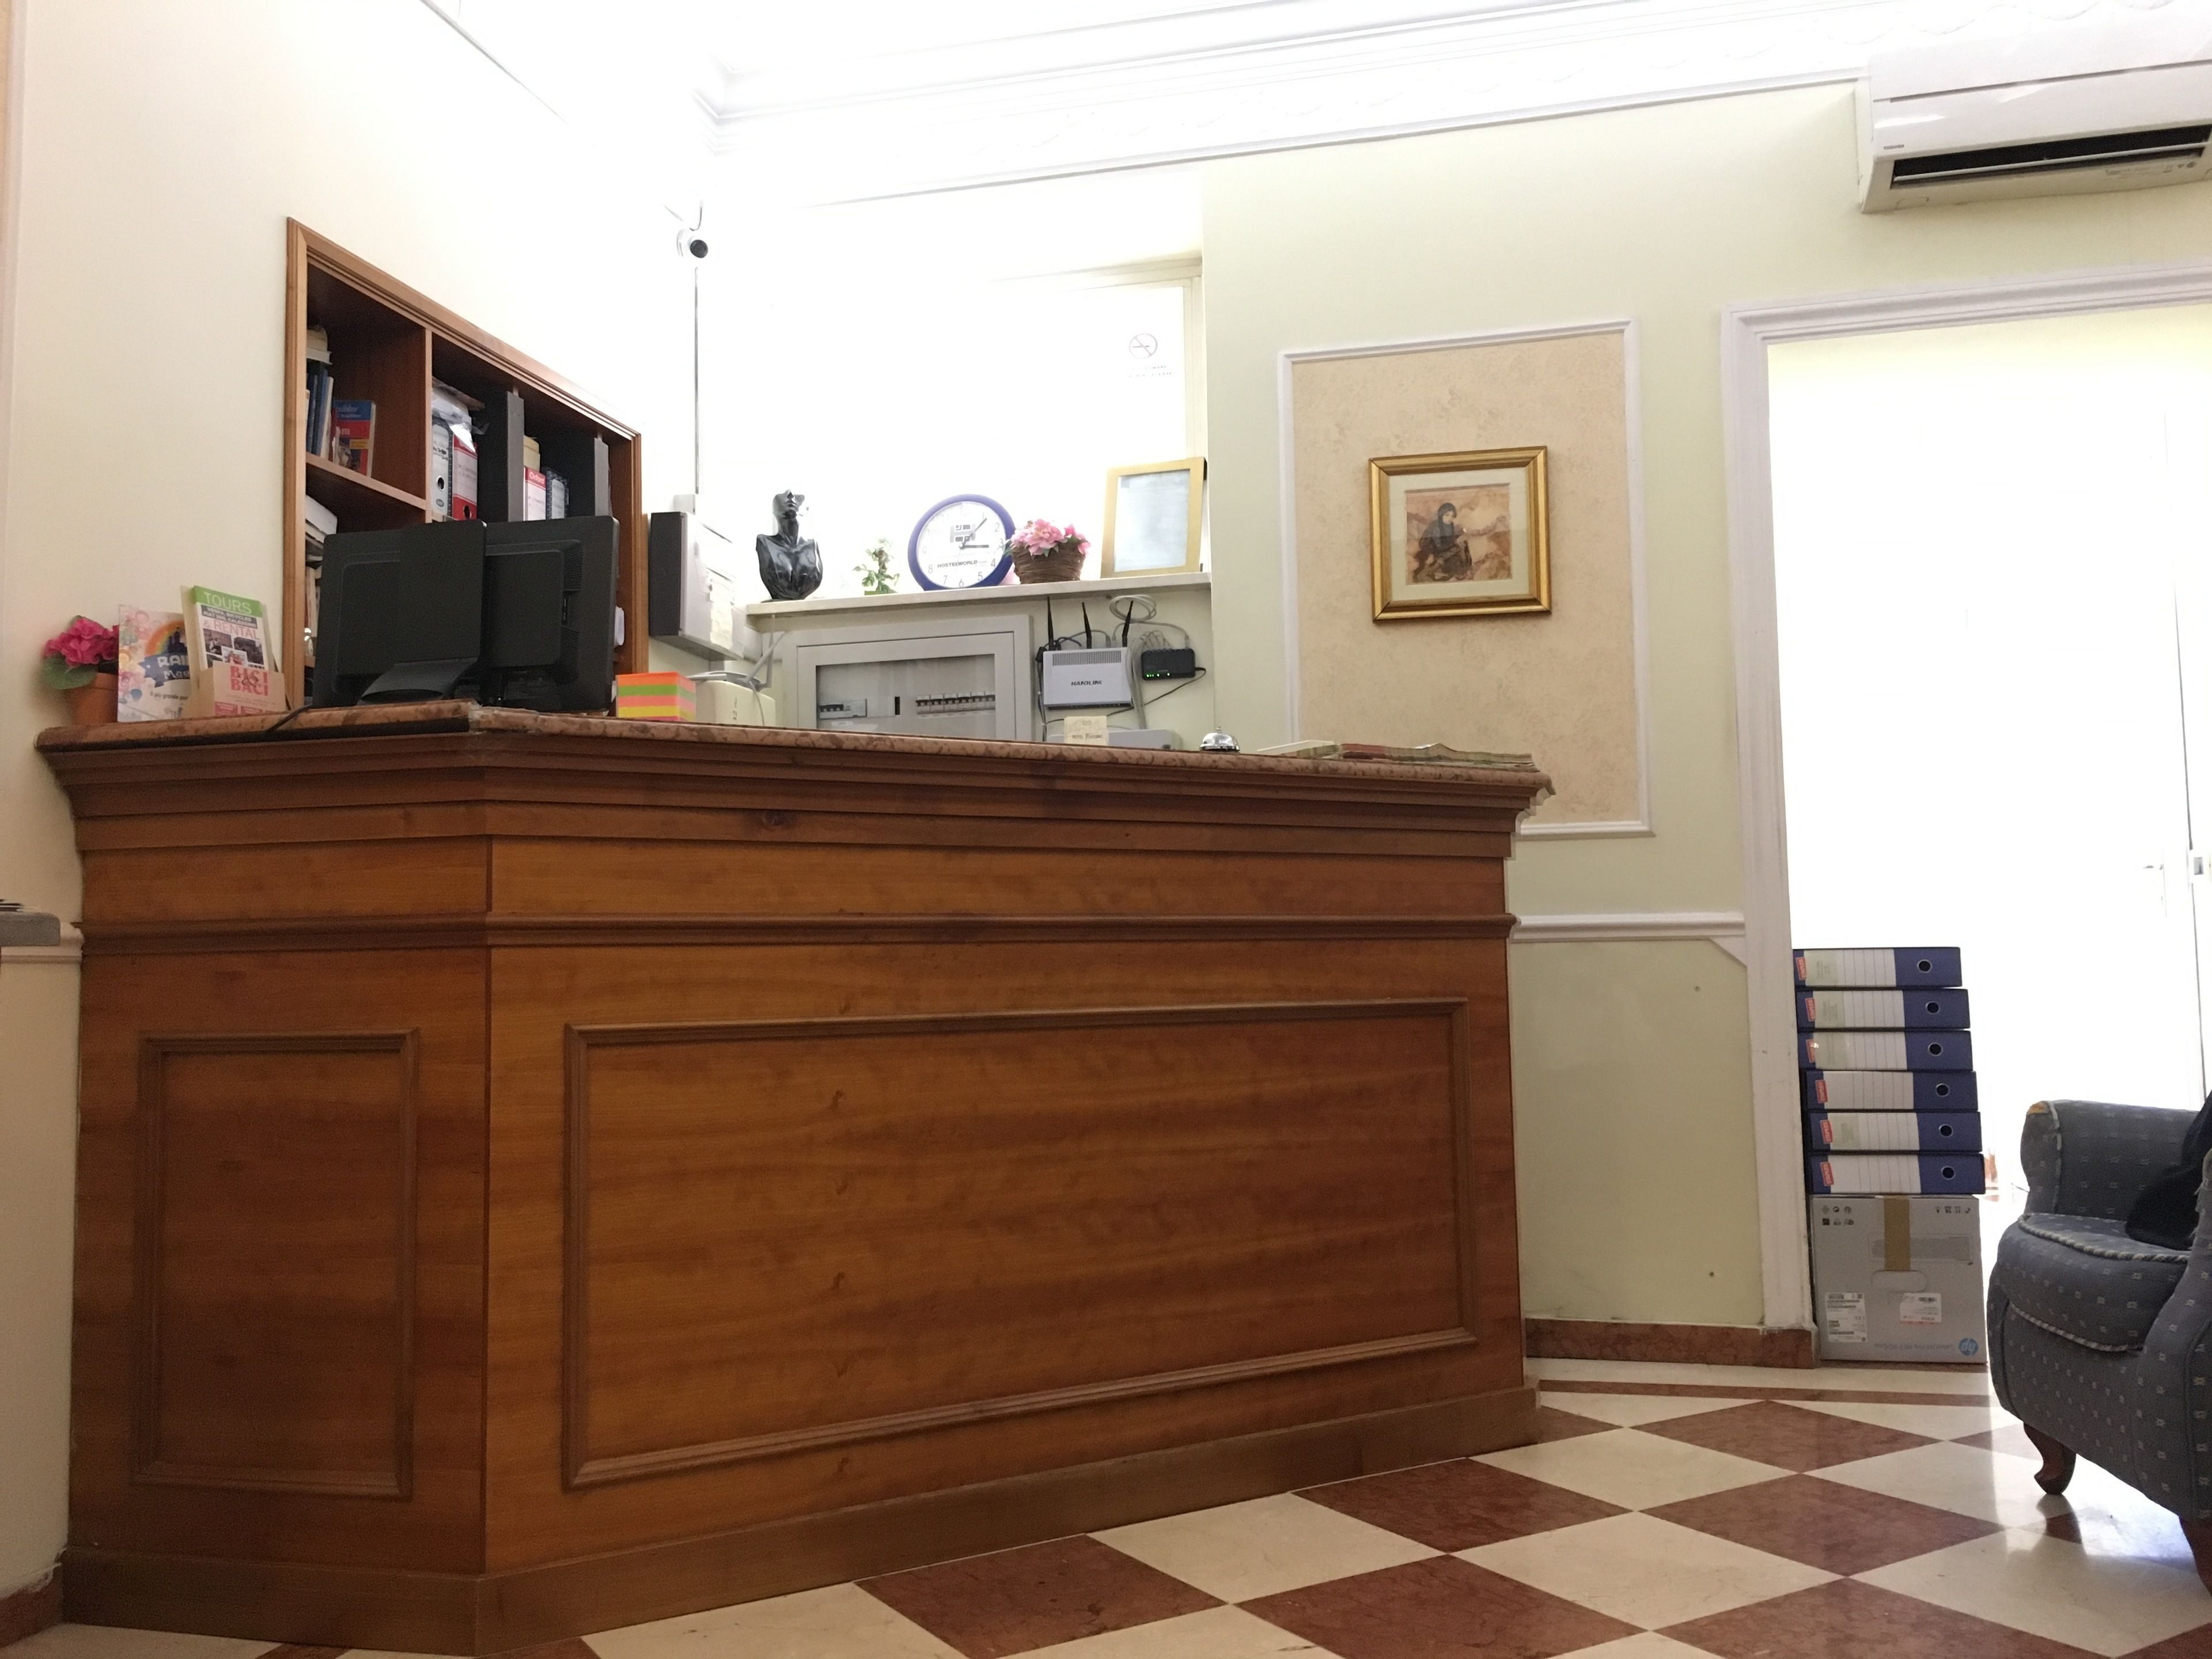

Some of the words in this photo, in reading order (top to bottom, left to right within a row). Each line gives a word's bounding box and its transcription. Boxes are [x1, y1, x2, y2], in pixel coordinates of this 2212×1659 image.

[995, 522, 1000, 532] 2
[937, 560, 978, 568] HOSTELWORLD
[991, 558, 995, 567] 4
[927, 565, 933, 574] 8
[943, 575, 948, 585] 7
[978, 571, 983, 581] 5
[959, 578, 964, 587] 6
[203, 592, 252, 614] TOURS
[214, 619, 260, 641] RENTAL
[231, 679, 268, 696] BACI
[1961, 1338, 1976, 1357] hp
